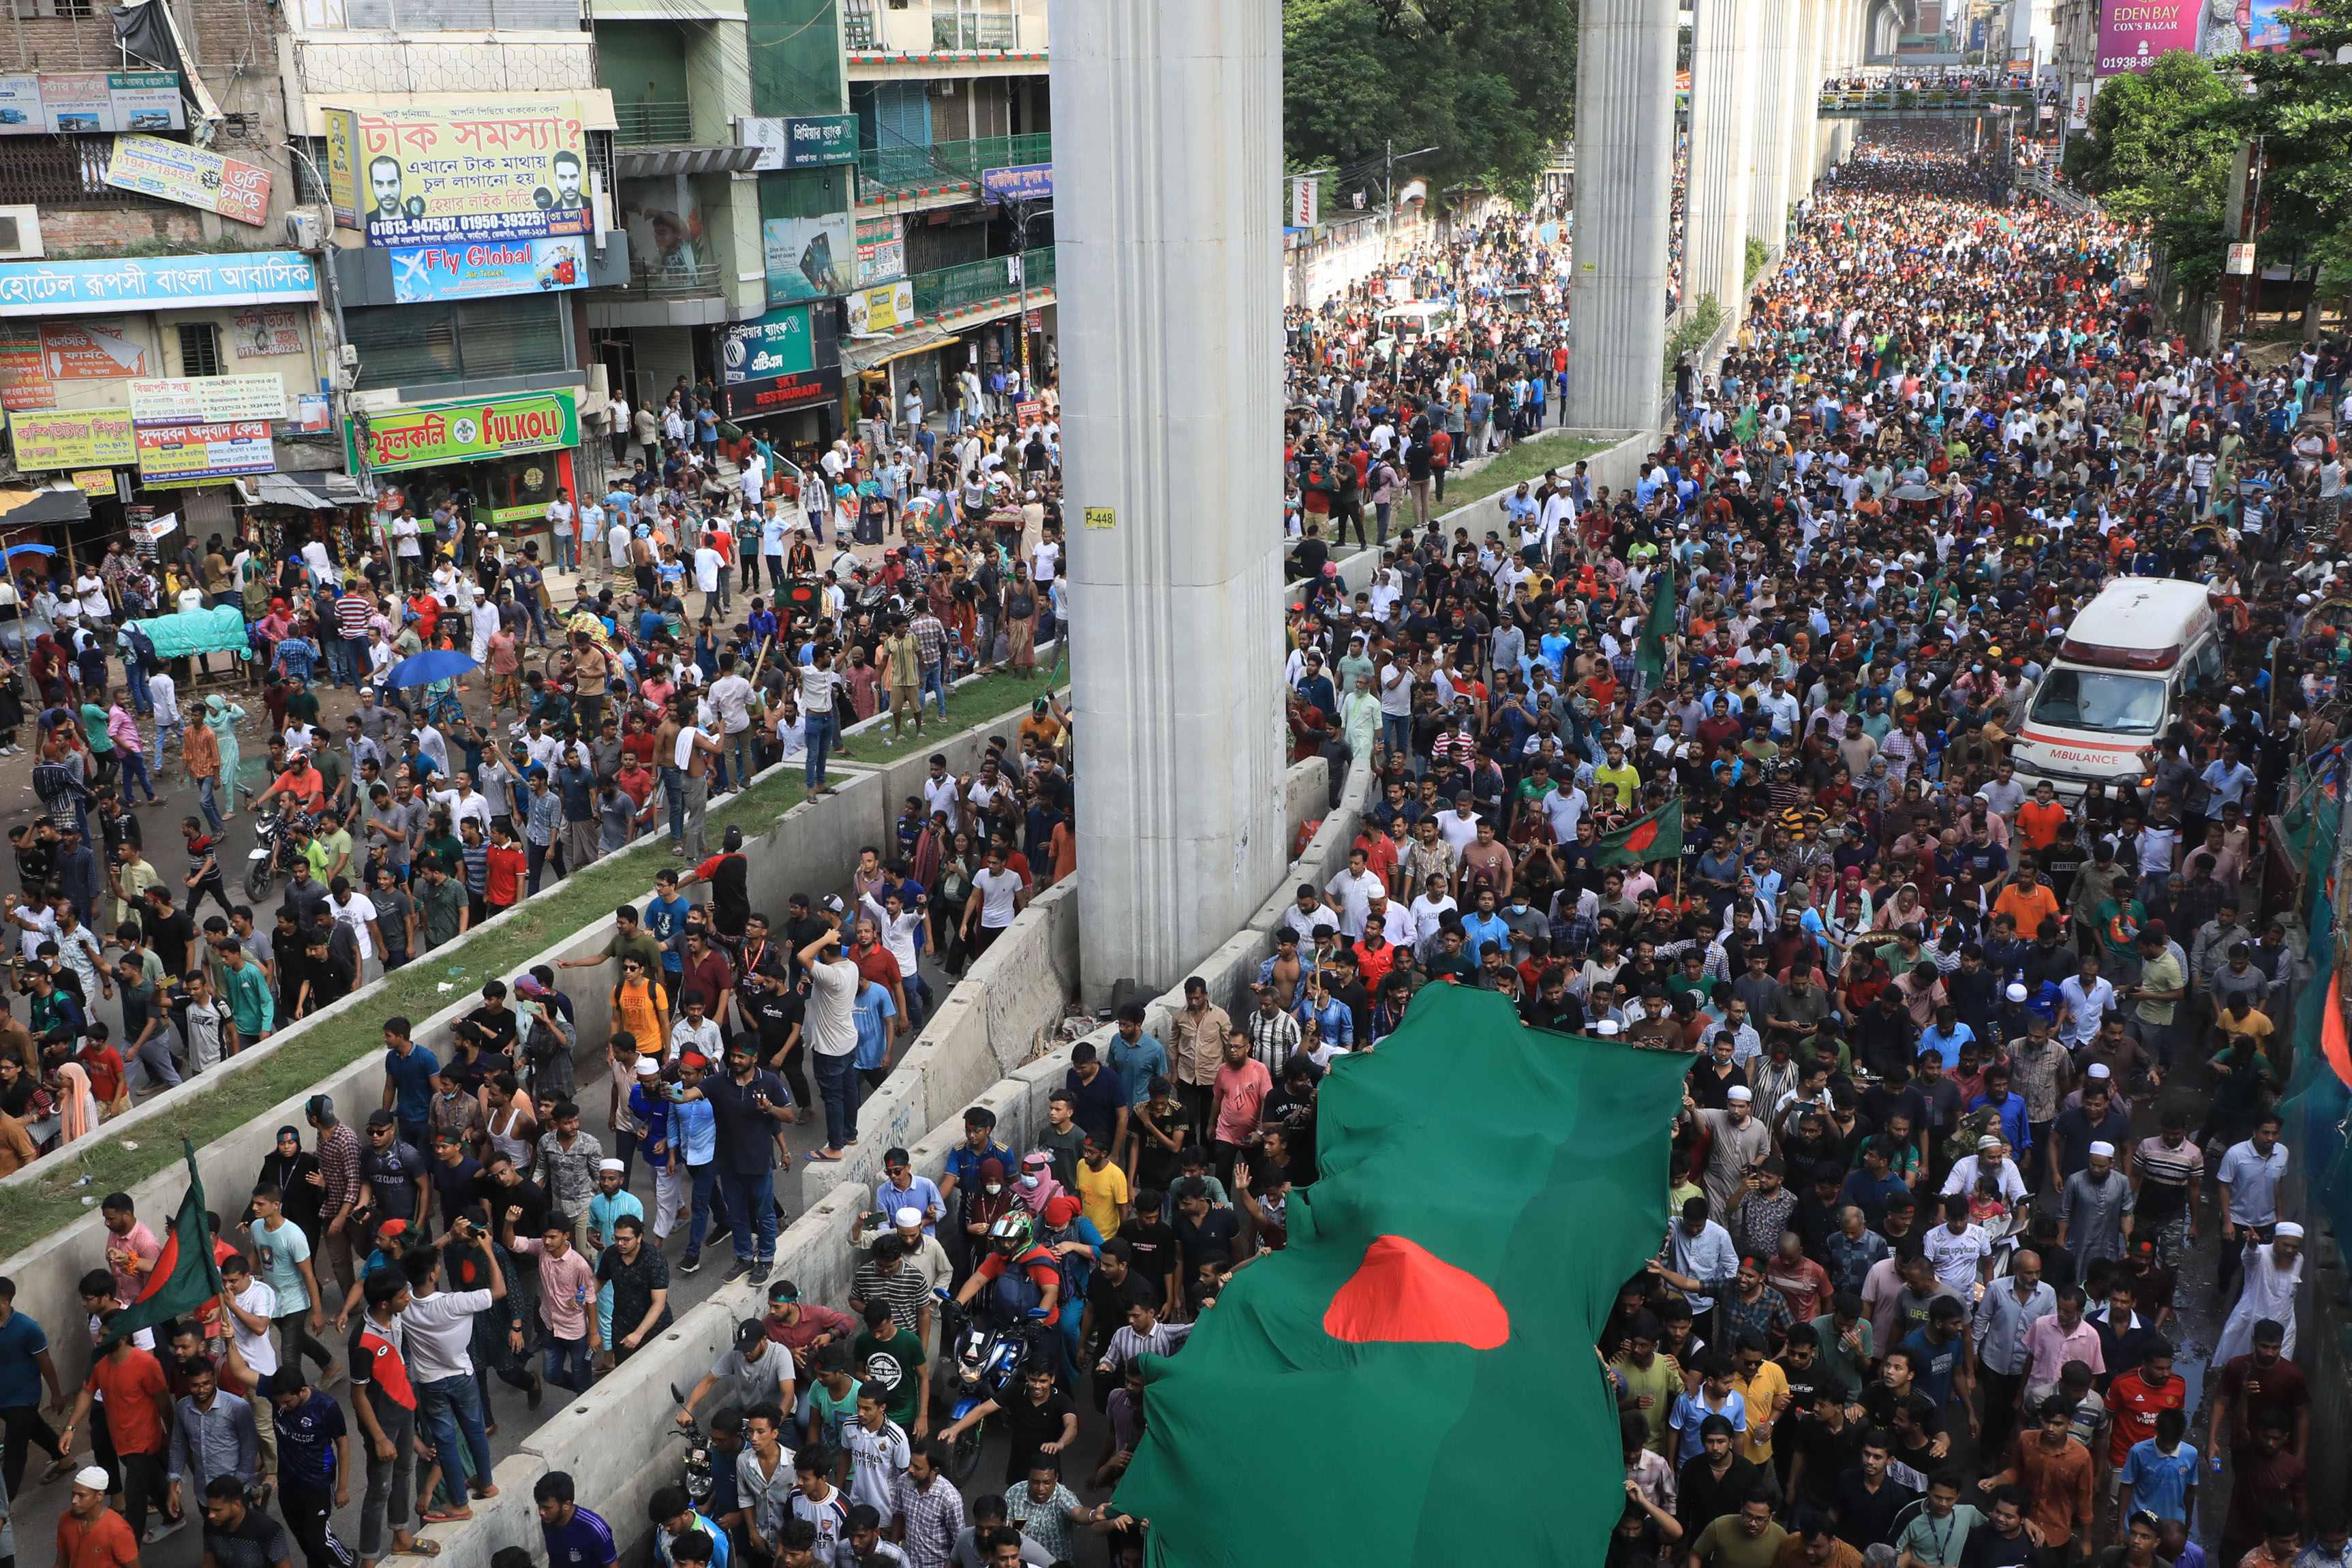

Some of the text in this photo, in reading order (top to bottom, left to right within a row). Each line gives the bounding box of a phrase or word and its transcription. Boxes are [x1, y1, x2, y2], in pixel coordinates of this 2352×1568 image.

[2114, 5, 2180, 21] EDEN BAY
[2145, 21, 2178, 31] BAZAR
[42, 80, 105, 93] স্টার লাইন
[449, 107, 475, 117] আপনি
[540, 105, 560, 114] কেন?
[2073, 96, 2086, 120] Apex
[358, 112, 583, 157] টাক সমস্যা?
[793, 123, 842, 142] প্রিমিয়ার ব্যাংক
[116, 154, 199, 184] 01947-184551
[406, 155, 547, 176] এখানে টাক মাথায়
[230, 170, 270, 189] ভর্তি
[423, 176, 445, 194] চুল
[453, 173, 508, 190] লাগানো
[221, 183, 265, 213] চলছে
[429, 191, 532, 214] হেয়ার লাইক বিডি
[1300, 180, 1309, 225] Bata
[425, 243, 532, 275] Fly Global
[0, 257, 311, 305] হোটেল রূপসী বাংলা আবাসিক
[466, 269, 504, 279] Air Ticket
[764, 322, 787, 337] ব্যাংক
[752, 351, 783, 371] এটিএম
[776, 375, 798, 389] SKY
[755, 383, 823, 405] RESTAURANT
[15, 418, 129, 442] কম্পিউটার শিখুন
[137, 420, 264, 446] সুন্দরবন অনুবাদ কেন্দ্র
[482, 406, 558, 445] FULKOLI
[370, 412, 448, 464] ফুলকলি
[1086, 512, 1112, 524] P-448
[2049, 749, 2118, 765] MBULANCE
[1276, 1104, 1287, 1114] TOM
[383, 1174, 403, 1184] CLOUD
[1951, 1242, 1976, 1255] spykar
[1910, 1308, 1929, 1321] OPE
[851, 1448, 883, 1463] Emirates
